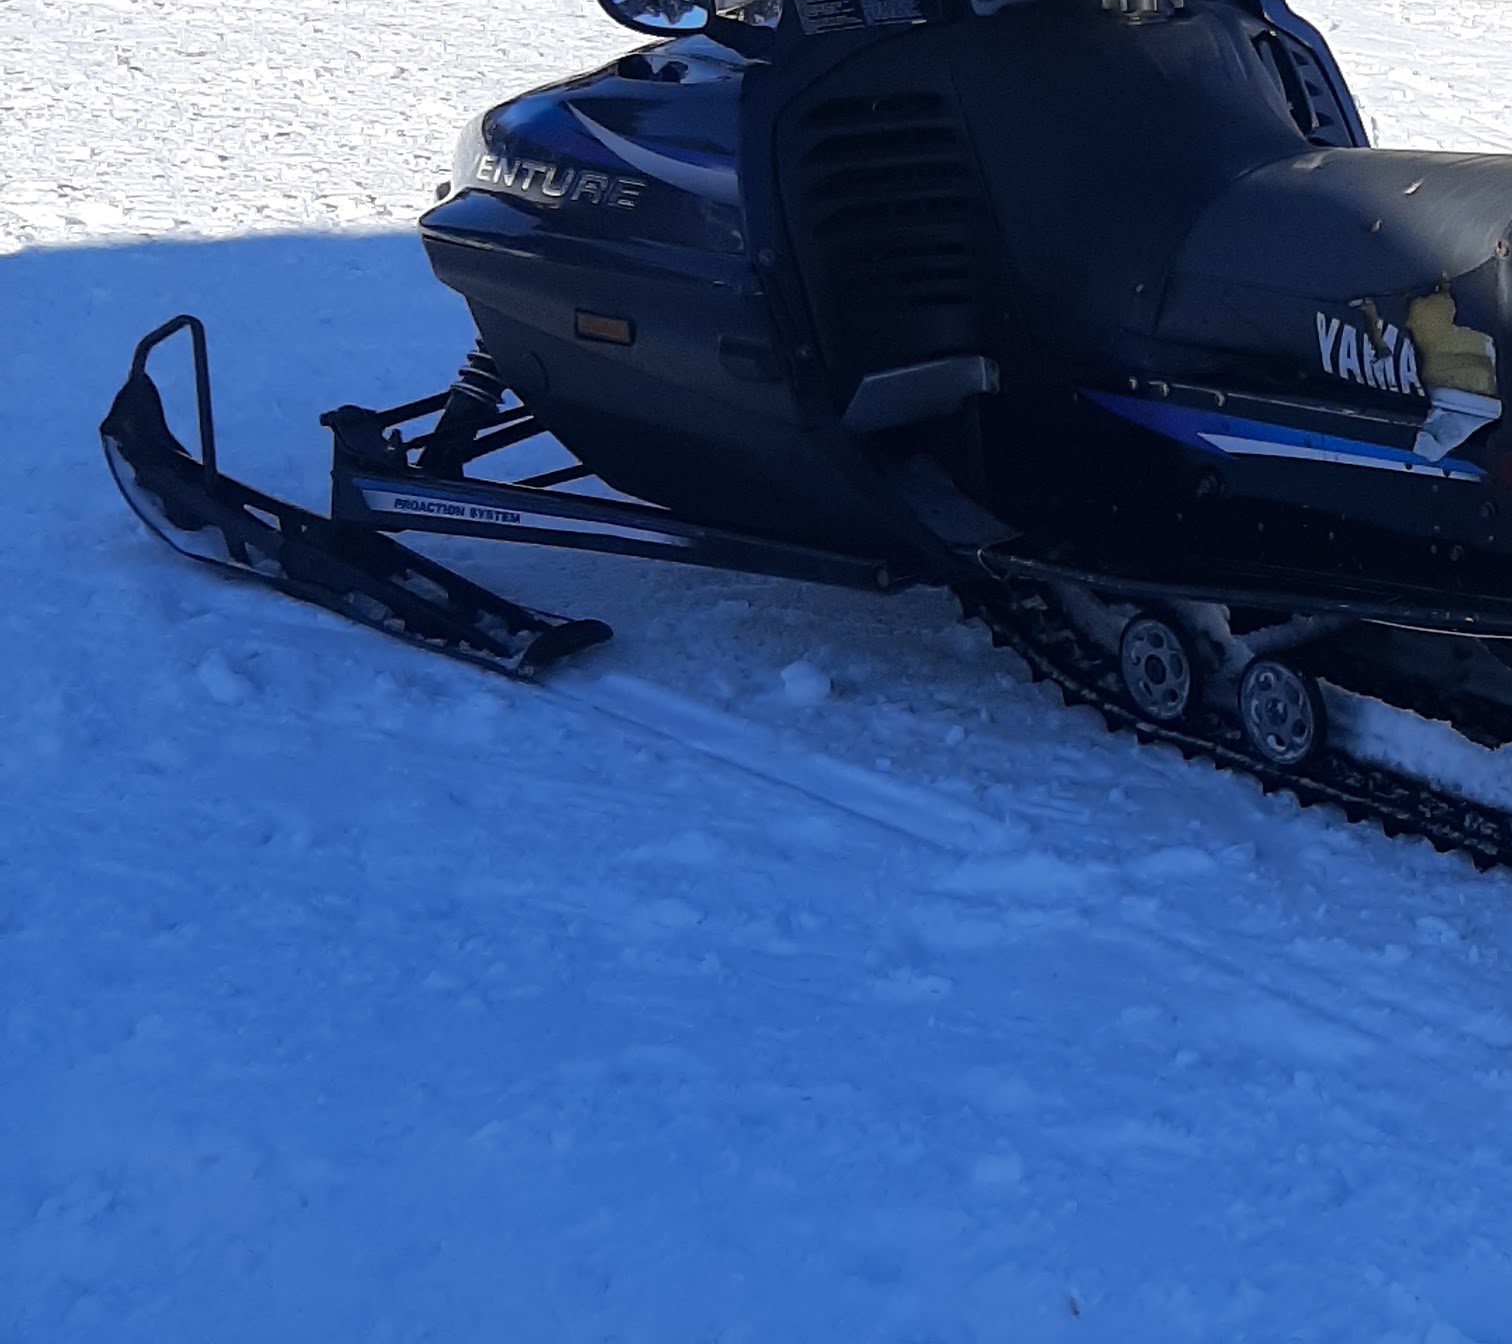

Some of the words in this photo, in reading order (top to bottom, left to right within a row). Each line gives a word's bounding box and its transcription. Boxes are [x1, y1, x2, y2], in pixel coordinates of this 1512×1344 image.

[474, 154, 646, 212] ENTURE
[394, 498, 465, 517] PROACTION
[470, 507, 520, 523] SYSTEM
